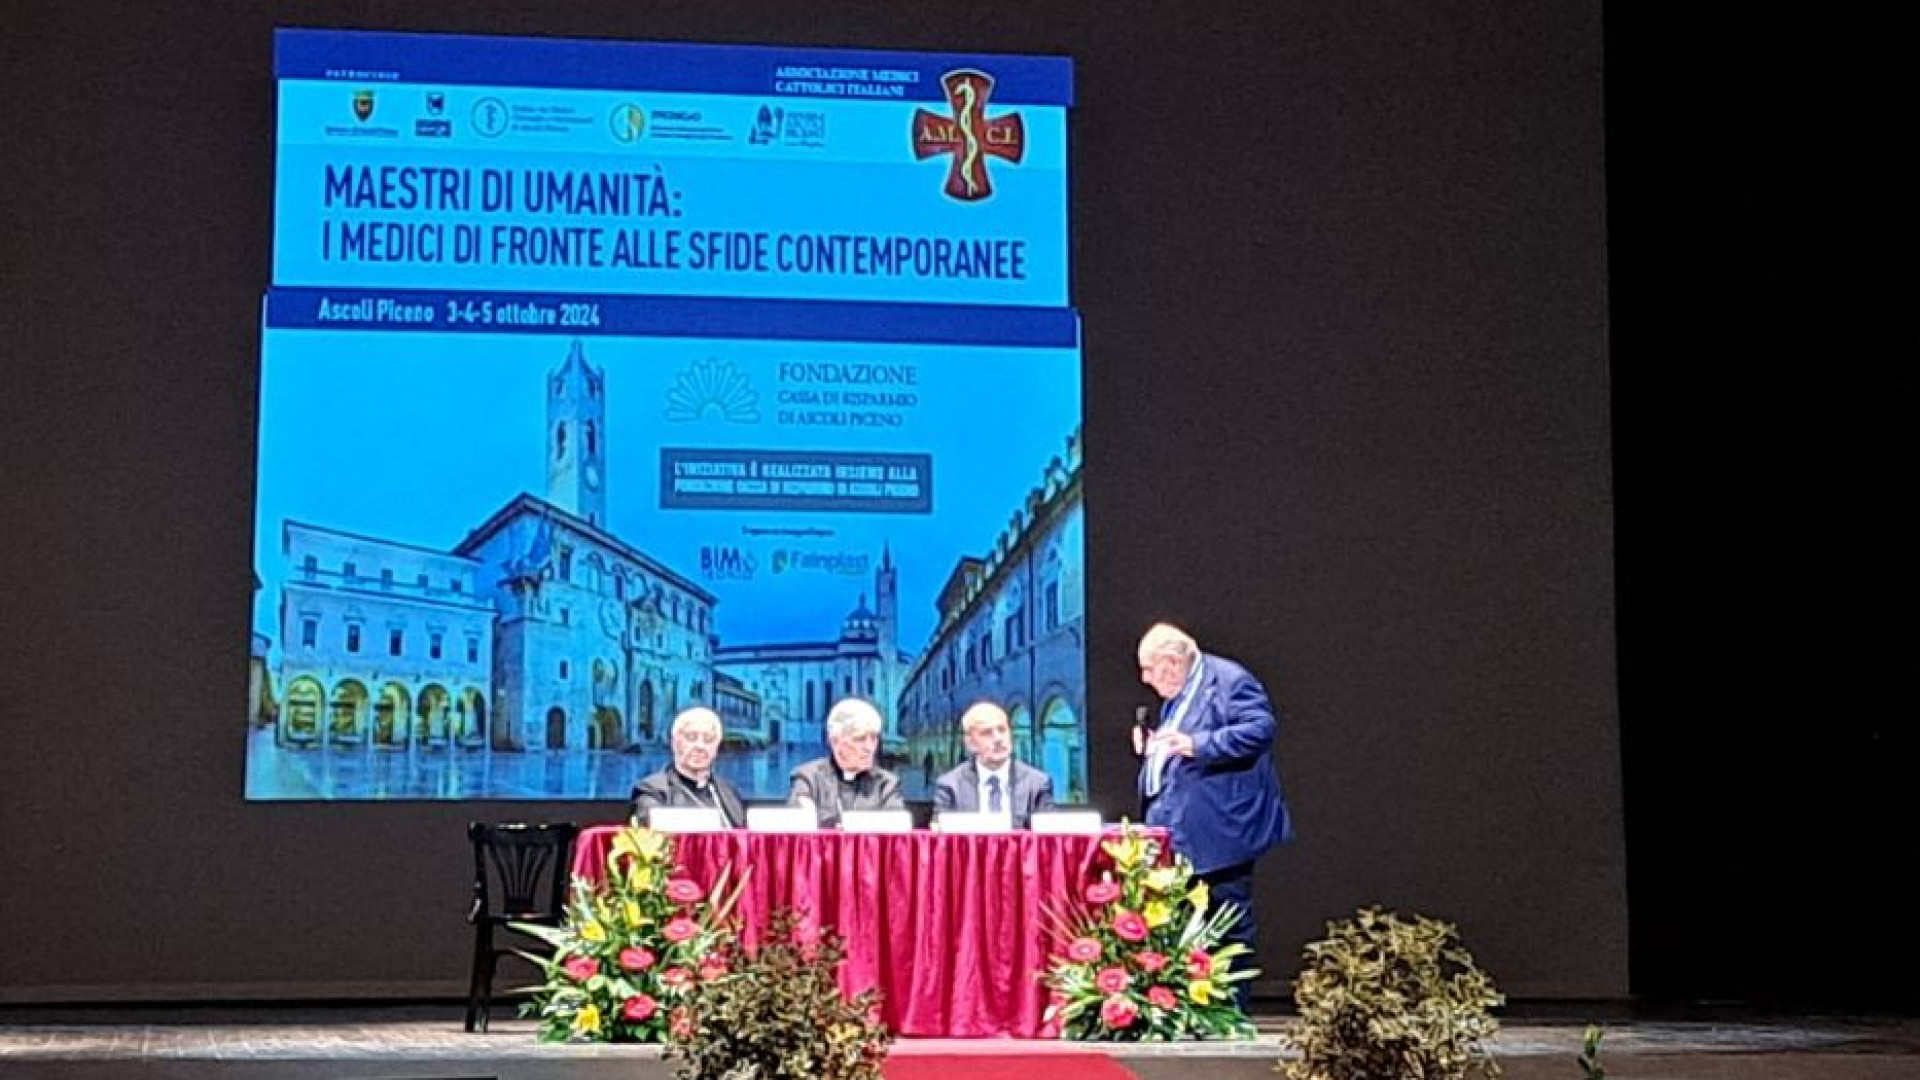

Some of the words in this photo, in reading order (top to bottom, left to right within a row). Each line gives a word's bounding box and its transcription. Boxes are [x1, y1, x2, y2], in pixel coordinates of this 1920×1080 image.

[325, 164, 471, 210] MAESTRI
[482, 168, 513, 213] DI
[524, 163, 682, 217] UMANITÀ:
[323, 220, 330, 262] I
[341, 221, 444, 263] MEDICI
[453, 224, 481, 264] DI
[491, 225, 604, 268] FRONTE
[612, 228, 681, 269] ALLE
[688, 231, 769, 272] SFIDE
[777, 233, 1026, 280] CONTEMPORANEE
[318, 298, 373, 323] Ascoli
[376, 299, 435, 324] Piceno
[446, 301, 493, 325] 3-4-5
[495, 302, 556, 326] ottobre
[559, 303, 600, 327] 2024
[778, 361, 919, 386] FONDAZIONE
[701, 546, 742, 570] BIM
